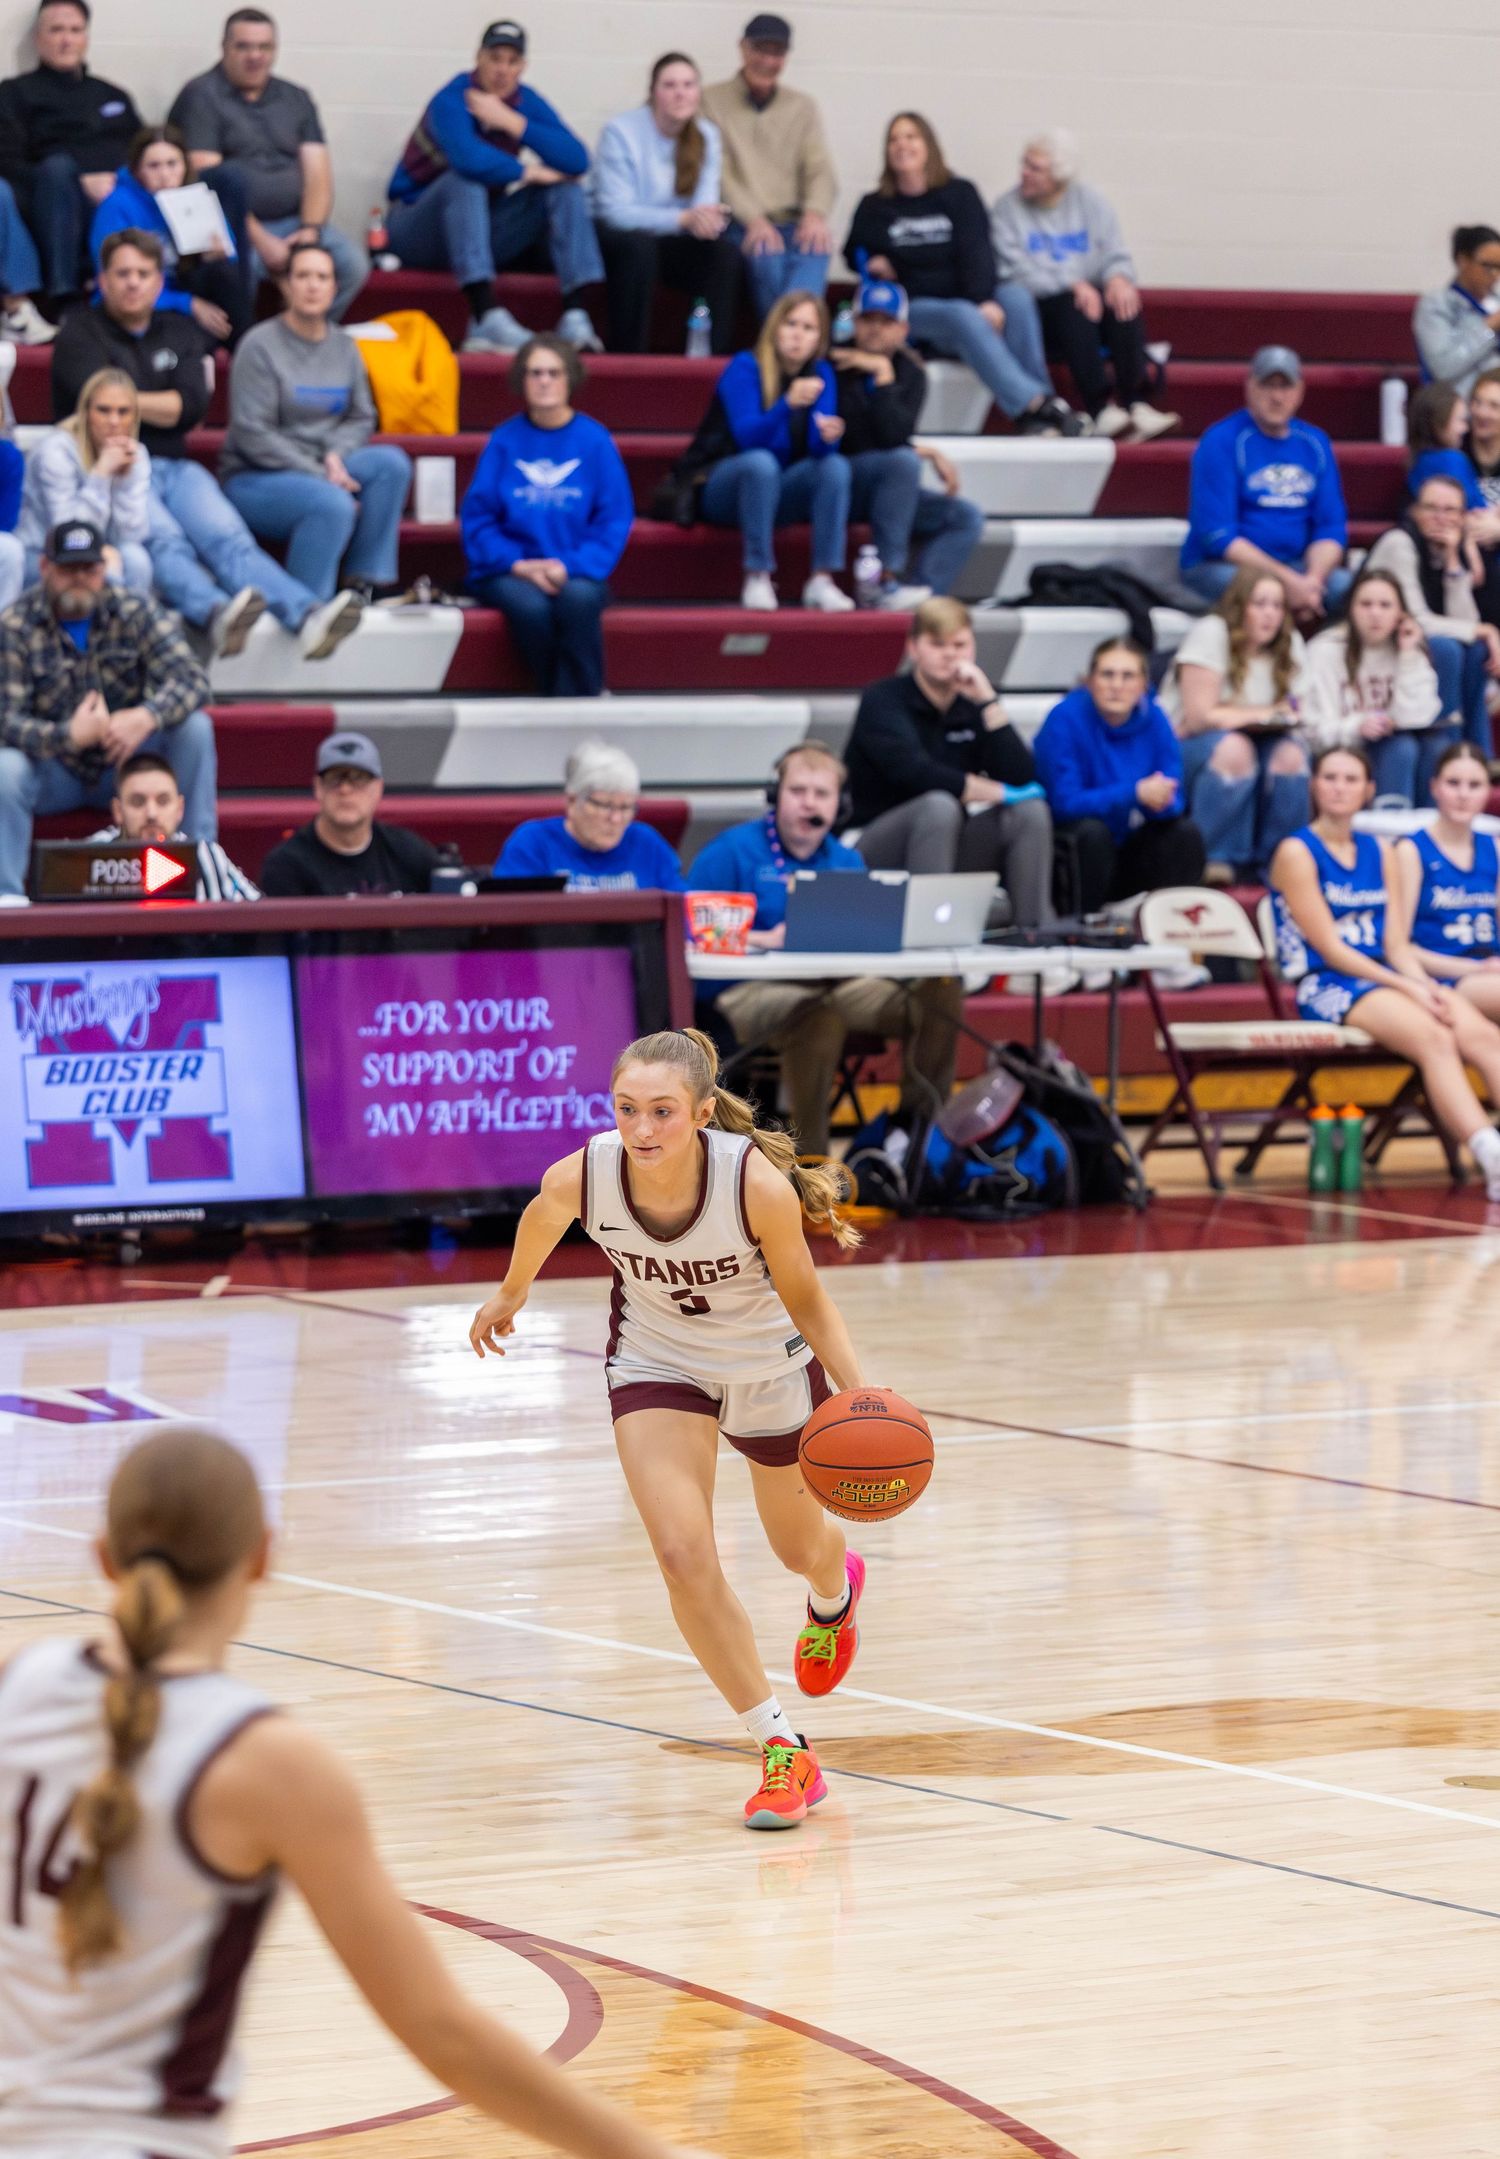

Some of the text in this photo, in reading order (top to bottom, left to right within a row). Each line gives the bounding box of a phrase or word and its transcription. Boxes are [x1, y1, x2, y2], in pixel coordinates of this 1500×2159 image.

[90, 858, 142, 884] POSS
[454, 996, 554, 1033] YOUR
[44, 1054, 204, 1086] BOOSTER
[361, 1038, 578, 1088] SUPPORT OF
[81, 1086, 172, 1115] CLUB
[363, 1101, 424, 1138] MV
[831, 1486, 911, 1503] LEGACY
